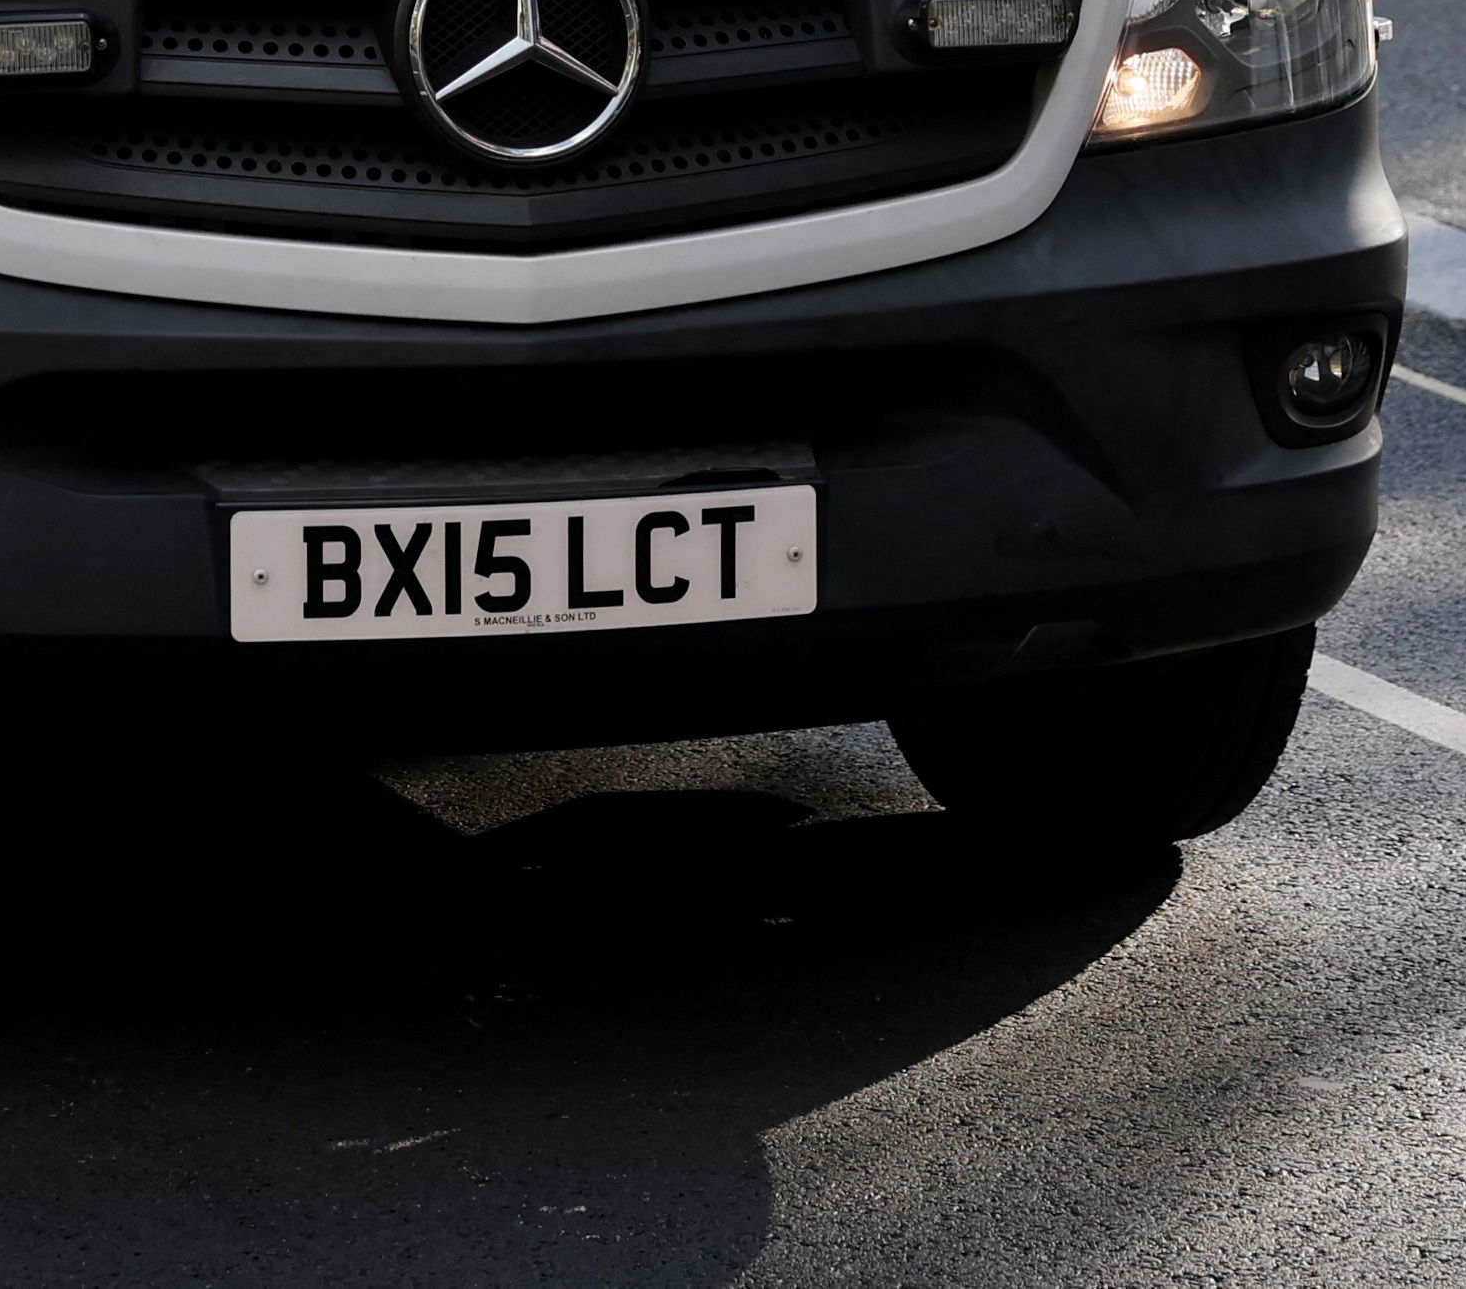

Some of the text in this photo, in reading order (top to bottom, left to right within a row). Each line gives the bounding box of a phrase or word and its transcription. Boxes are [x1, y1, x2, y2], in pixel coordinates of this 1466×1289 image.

[303, 505, 755, 619] BX15 LCT
[474, 617, 481, 626] S
[483, 614, 542, 626] MACNEILLIE
[545, 614, 551, 623] &
[554, 612, 575, 622] SON
[578, 611, 596, 621] LTD
